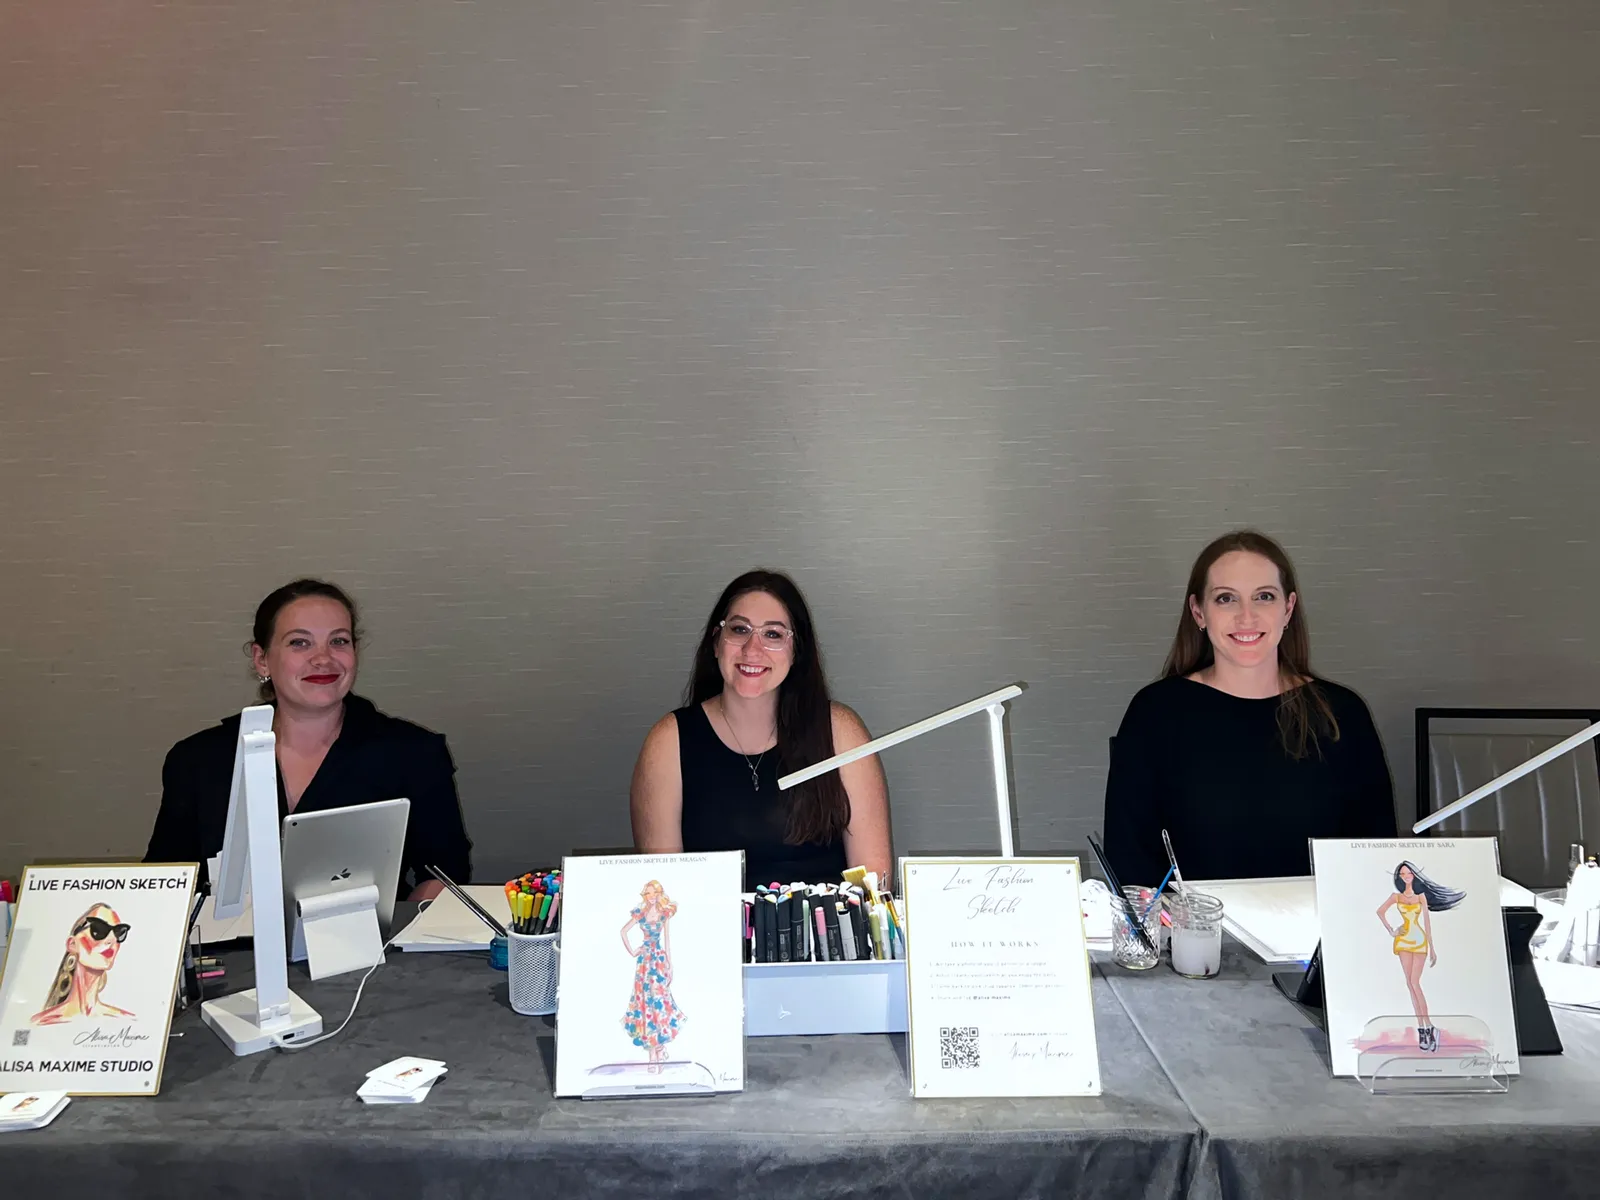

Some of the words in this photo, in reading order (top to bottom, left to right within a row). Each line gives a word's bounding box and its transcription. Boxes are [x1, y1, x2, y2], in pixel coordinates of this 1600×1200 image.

[615, 858, 642, 866] FASHION
[28, 879, 59, 891] LIVE
[62, 879, 126, 891] FASHION
[129, 878, 188, 890] SKETCH
[967, 894, 1023, 920] Sketch
[39, 1060, 97, 1073] MAXIME
[100, 1060, 154, 1073] STUDIO
